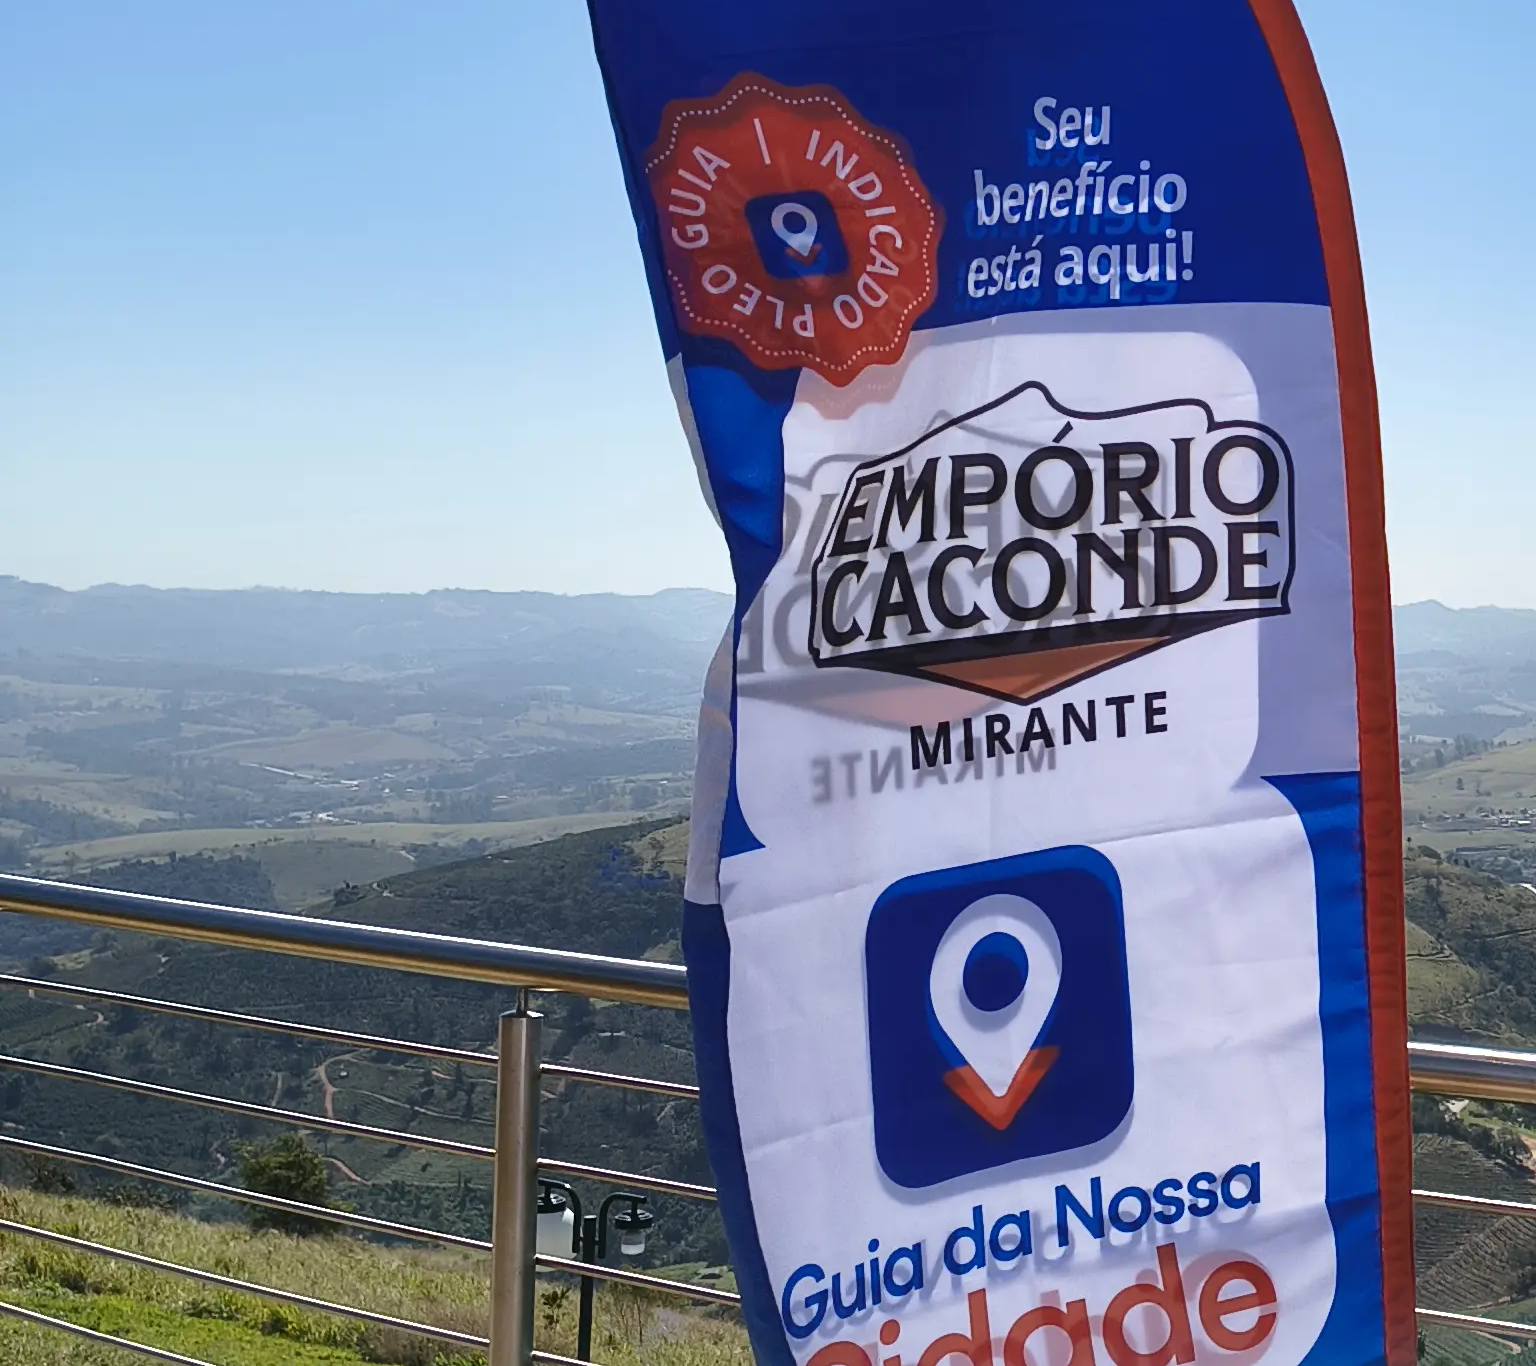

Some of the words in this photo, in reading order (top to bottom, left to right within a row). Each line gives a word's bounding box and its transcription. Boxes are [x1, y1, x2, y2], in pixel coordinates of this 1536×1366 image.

[1033, 96, 1111, 152] Seu
[669, 145, 731, 249] GUIA
[806, 129, 903, 329] INDICADO
[974, 160, 1188, 228] benefício
[702, 264, 815, 338] PLEO
[966, 237, 1042, 298] está
[1055, 228, 1194, 299] aqui!
[827, 421, 1281, 559] EMPÓRIO
[819, 521, 1281, 648] CACONDE
[910, 690, 1169, 771] MIRANTE
[780, 1238, 924, 1339] Guia
[943, 1204, 1033, 1275] da
[1054, 1161, 1262, 1247] Nossa
